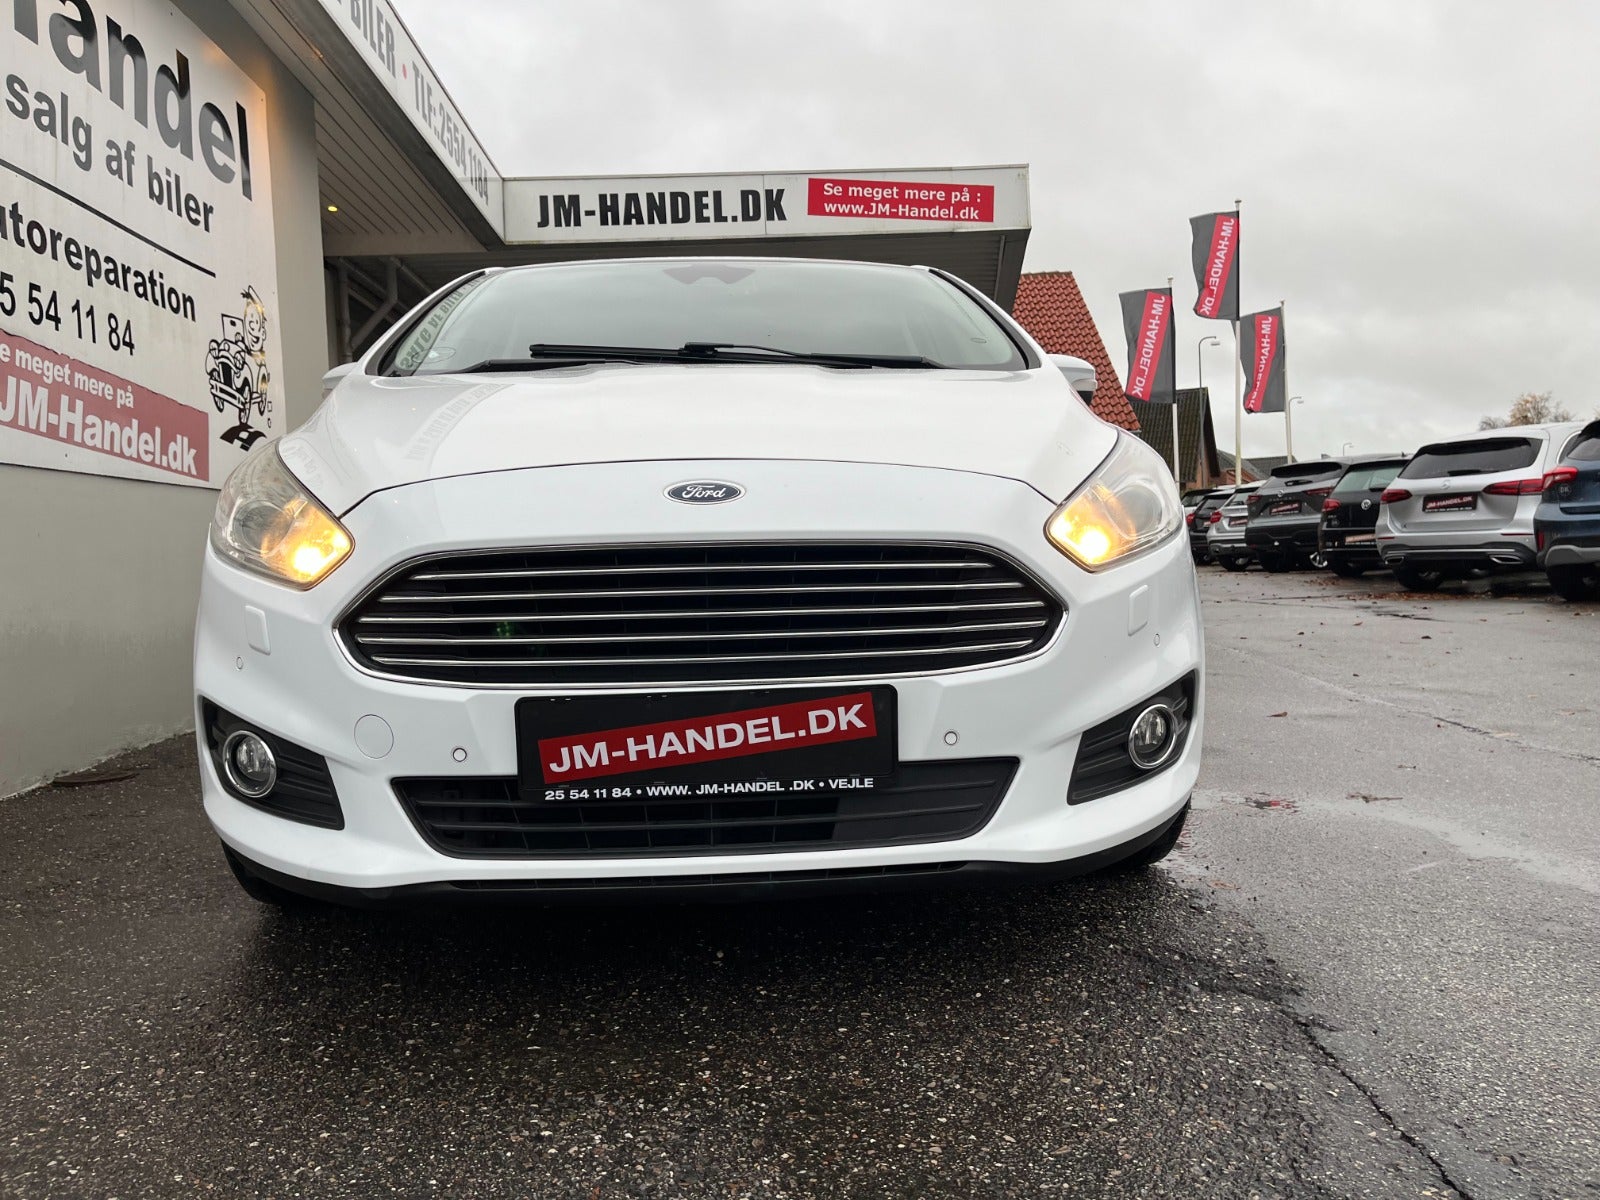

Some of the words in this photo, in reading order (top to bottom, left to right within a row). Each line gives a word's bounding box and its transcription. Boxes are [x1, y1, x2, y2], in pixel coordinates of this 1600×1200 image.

[5, 73, 92, 172] salg
[105, 138, 136, 187] af
[147, 154, 214, 233] biler
[537, 188, 787, 228] JM-HANDEL.DK
[823, 183, 843, 197] Se
[848, 185, 899, 201] meget
[904, 188, 945, 201] mere
[951, 187, 970, 204] på
[823, 201, 979, 220] www.JM-Handel.dk
[28, 281, 62, 332] 54
[71, 299, 97, 344] 11
[107, 312, 135, 356] 84
[15, 348, 71, 385] meget
[74, 371, 113, 400] mere
[116, 384, 134, 409] på
[0, 375, 197, 475] JM-Handel.dk
[681, 484, 727, 499] Ford
[549, 703, 867, 773] JM-HANDEL.DK
[544, 790, 565, 801] 25
[569, 789, 590, 799] 54
[593, 788, 607, 798] 11
[611, 787, 632, 798] 84
[646, 785, 691, 796] WWW.
[696, 781, 785, 795] JM-HANDEL
[828, 777, 874, 789] VEJLE
